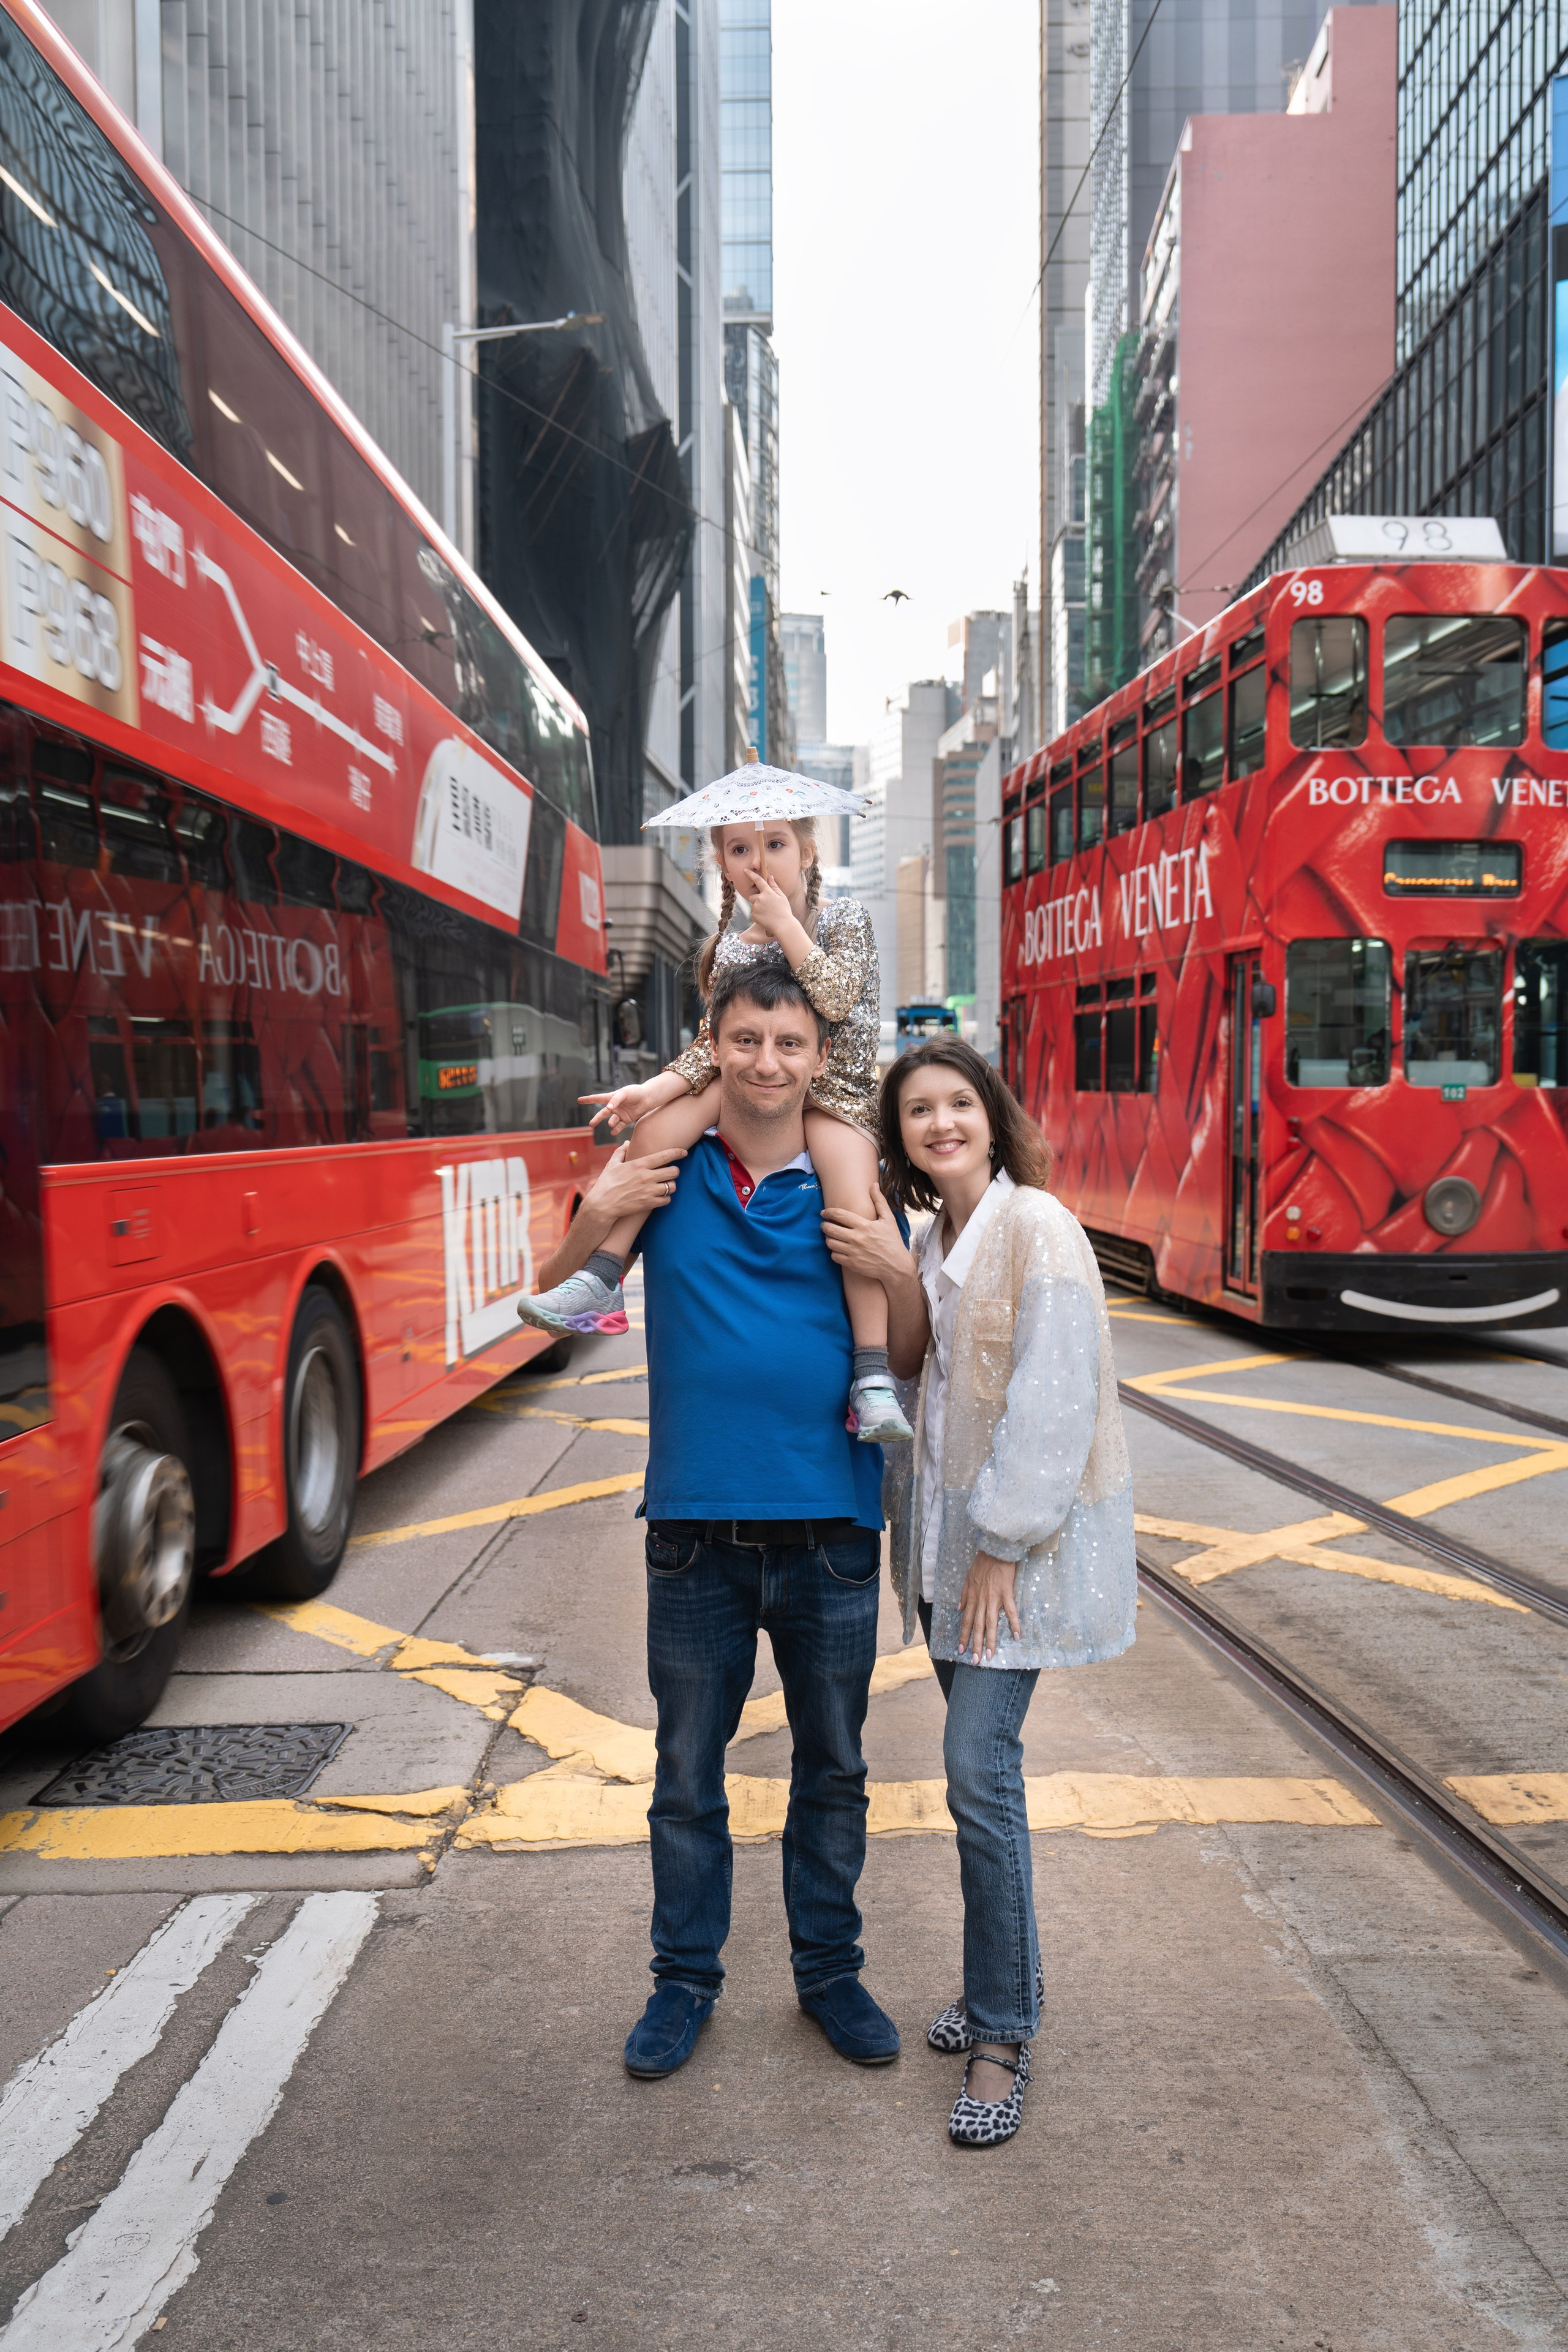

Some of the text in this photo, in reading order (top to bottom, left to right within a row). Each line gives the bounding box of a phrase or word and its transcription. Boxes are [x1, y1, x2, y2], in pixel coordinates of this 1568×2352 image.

[1381, 521, 1452, 551] 98
[1290, 579, 1324, 607] 98
[1308, 775, 1463, 805] BOTTEGA
[1024, 839, 1213, 966] BOTTEGA VENETA
[1443, 1086, 1465, 1099] 102
